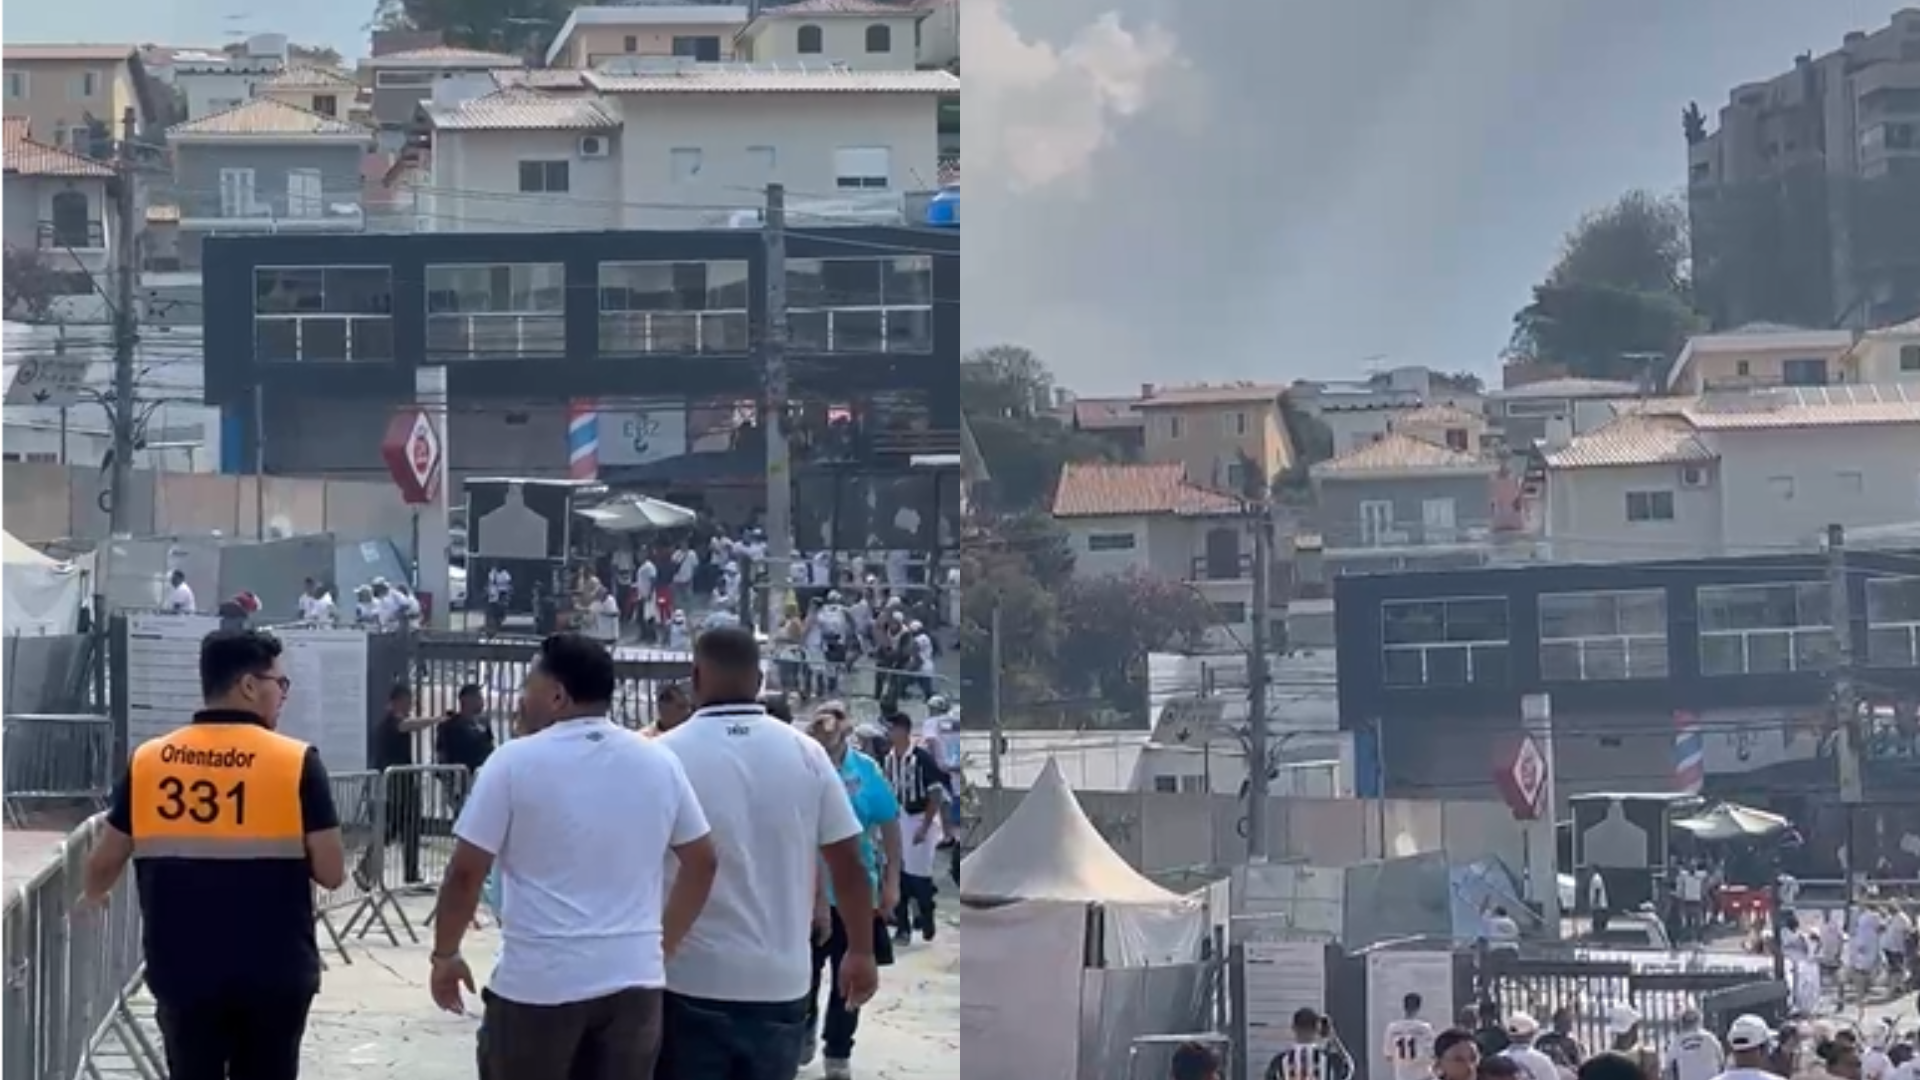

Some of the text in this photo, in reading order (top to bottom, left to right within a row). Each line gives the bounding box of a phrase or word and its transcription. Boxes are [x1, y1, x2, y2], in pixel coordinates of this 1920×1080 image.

[161, 744, 256, 768] Orientador
[157, 775, 246, 826] 331
[1395, 1037, 1416, 1059] 11
